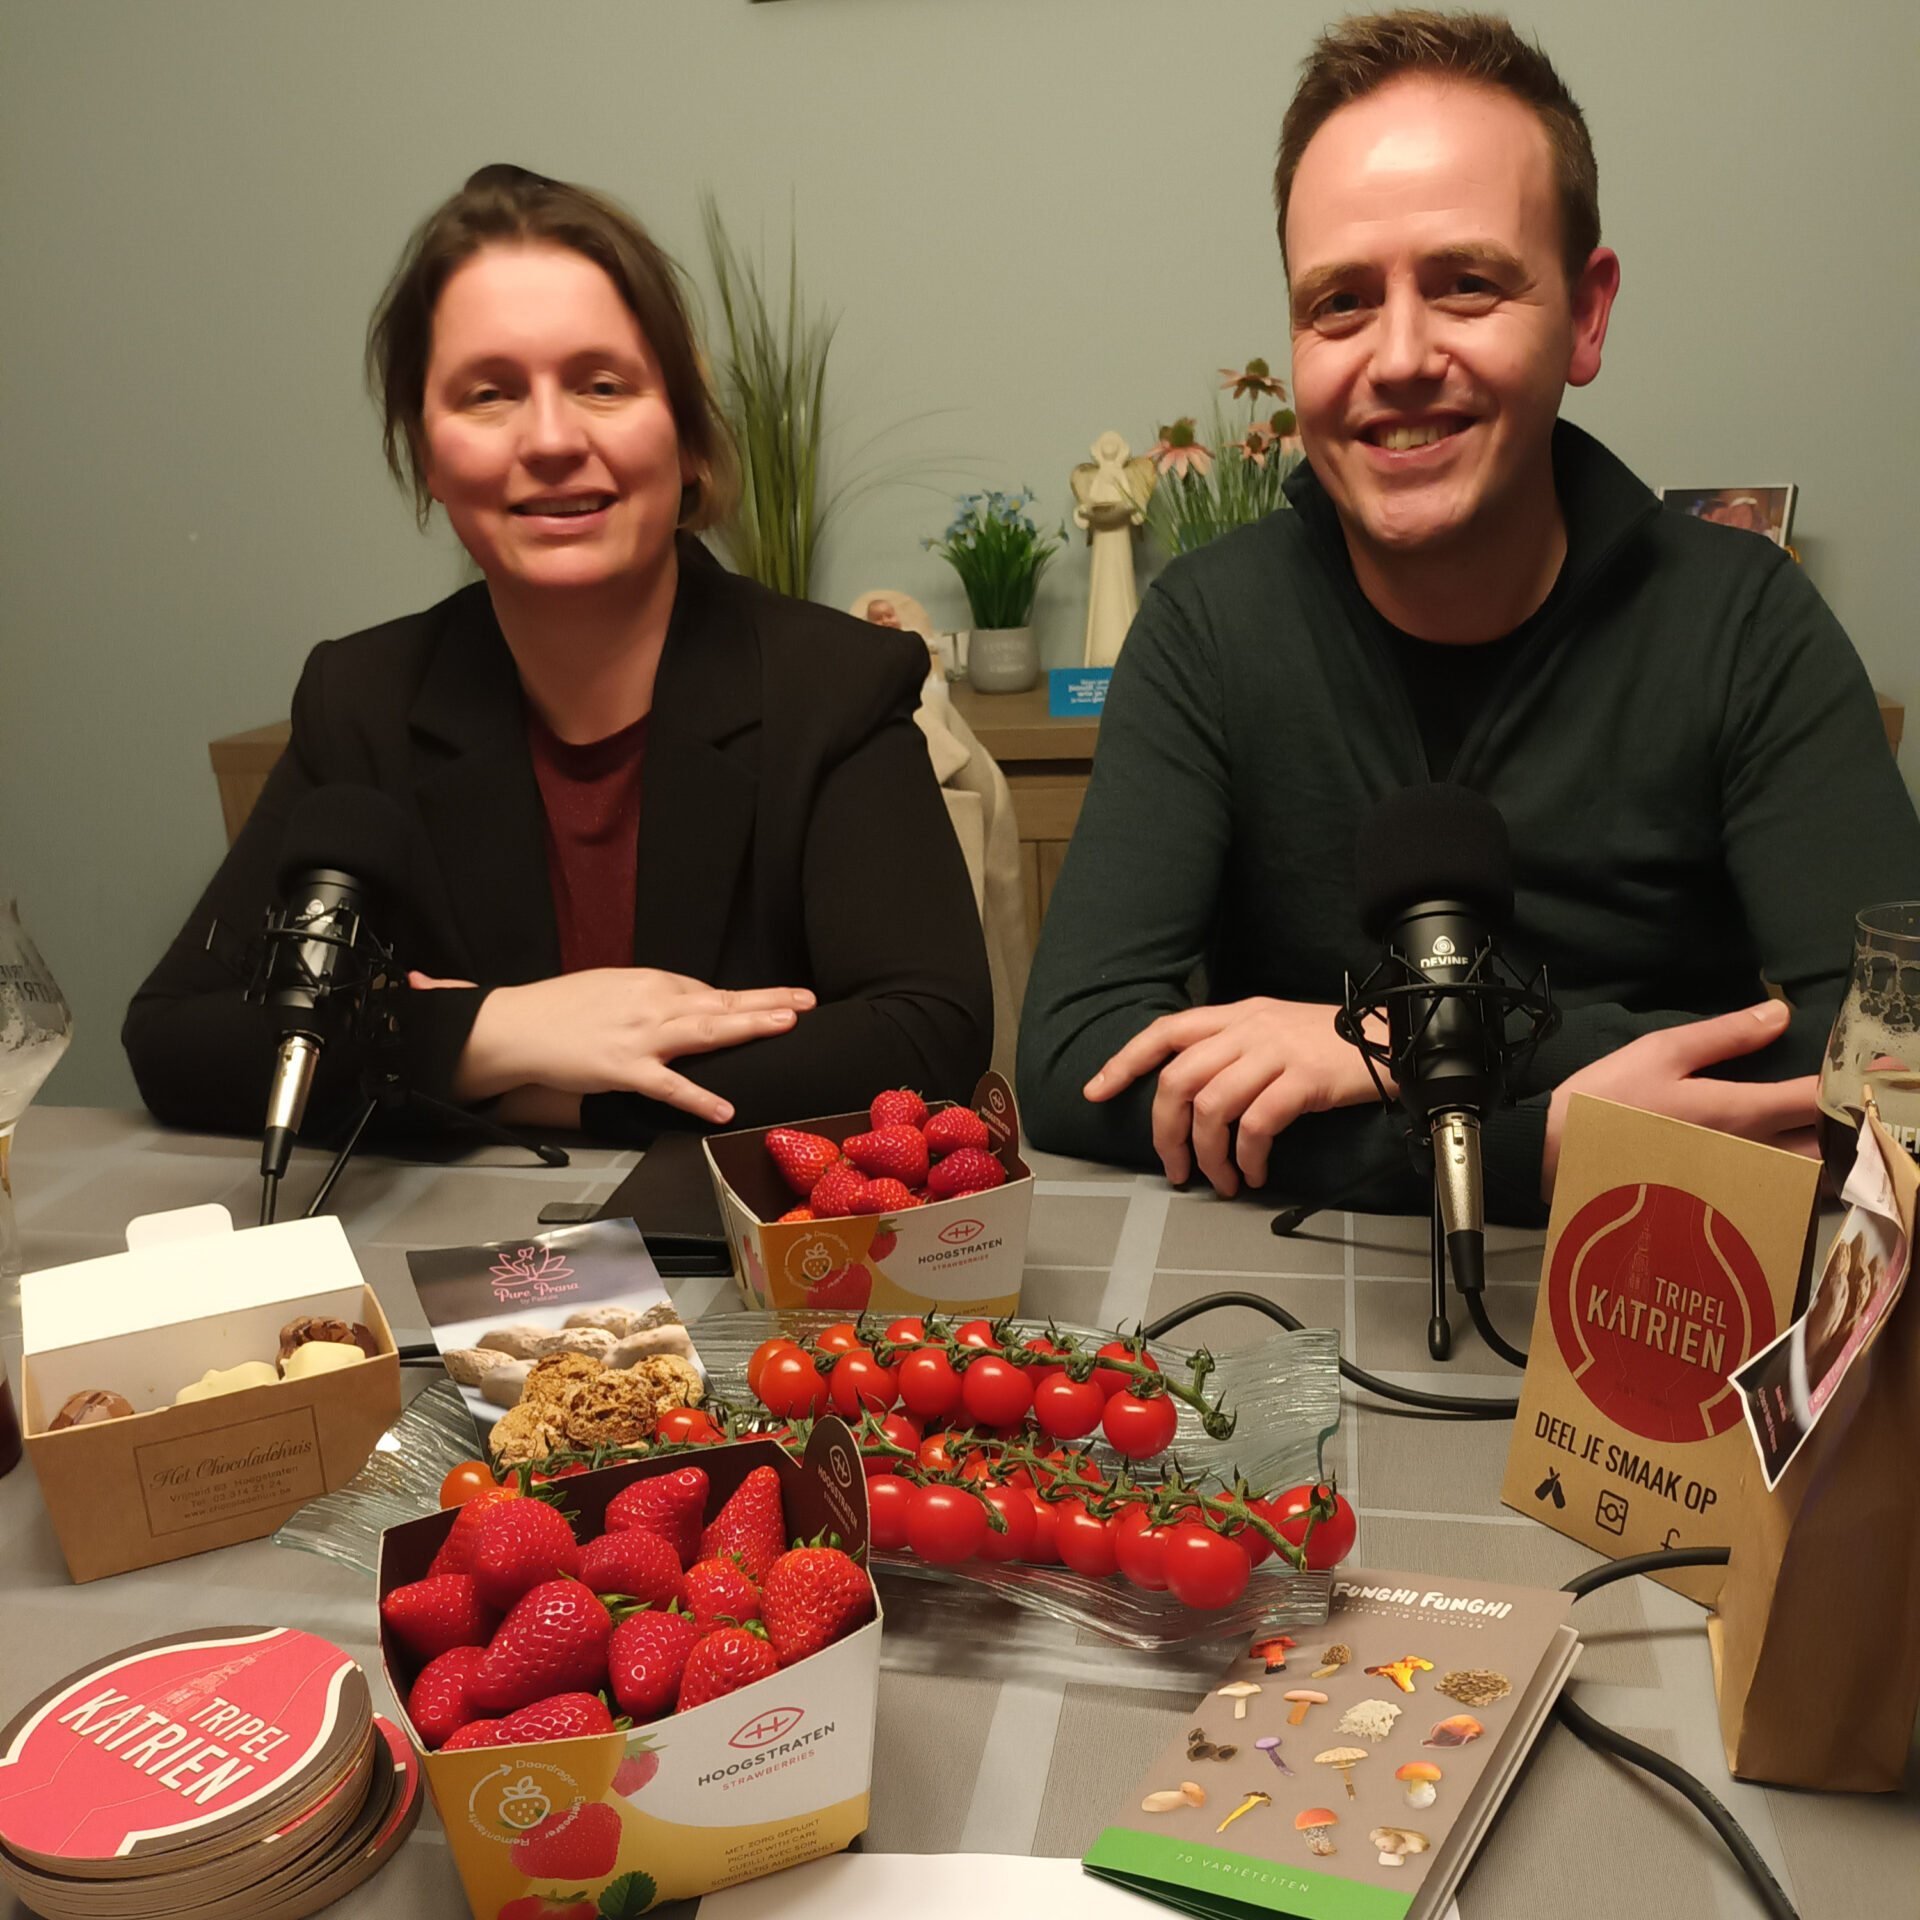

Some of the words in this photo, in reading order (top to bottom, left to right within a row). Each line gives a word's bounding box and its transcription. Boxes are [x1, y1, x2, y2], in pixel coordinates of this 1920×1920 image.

[918, 1237, 1003, 1265] HOOGSTRATEN
[494, 1288, 531, 1302] Pure
[533, 1282, 579, 1296] Prana
[1655, 1276, 1727, 1328] TRIPEL
[1587, 1285, 1727, 1375] KATRIEN
[150, 1465, 191, 1489] Het
[196, 1439, 313, 1480] Chocoladehuis
[1534, 1411, 1577, 1458] DEEL
[1580, 1437, 1602, 1466] JE
[1605, 1445, 1684, 1502] SMAAK
[1685, 1481, 1718, 1514] OP
[1333, 1583, 1419, 1605] FUNGHI
[1420, 1592, 1513, 1619] FUNGHI
[58, 1688, 255, 1805] KATRIEN
[189, 1697, 290, 1762] TRIPEL
[515, 1760, 578, 1787] Doordrager
[698, 1722, 836, 1787] HOOGSTRATEN
[722, 1750, 816, 1791] STRAWBERRIES
[725, 1845, 744, 1856] MET
[749, 1835, 775, 1849] ZORG
[777, 1819, 819, 1839] GEPLUKT
[728, 1848, 763, 1863] PICKED
[765, 1840, 791, 1852] WITH
[792, 1830, 817, 1843] CARE
[768, 1848, 792, 1860] AVEC
[794, 1839, 817, 1851] SOIN
[1176, 1853, 1194, 1865] 70
